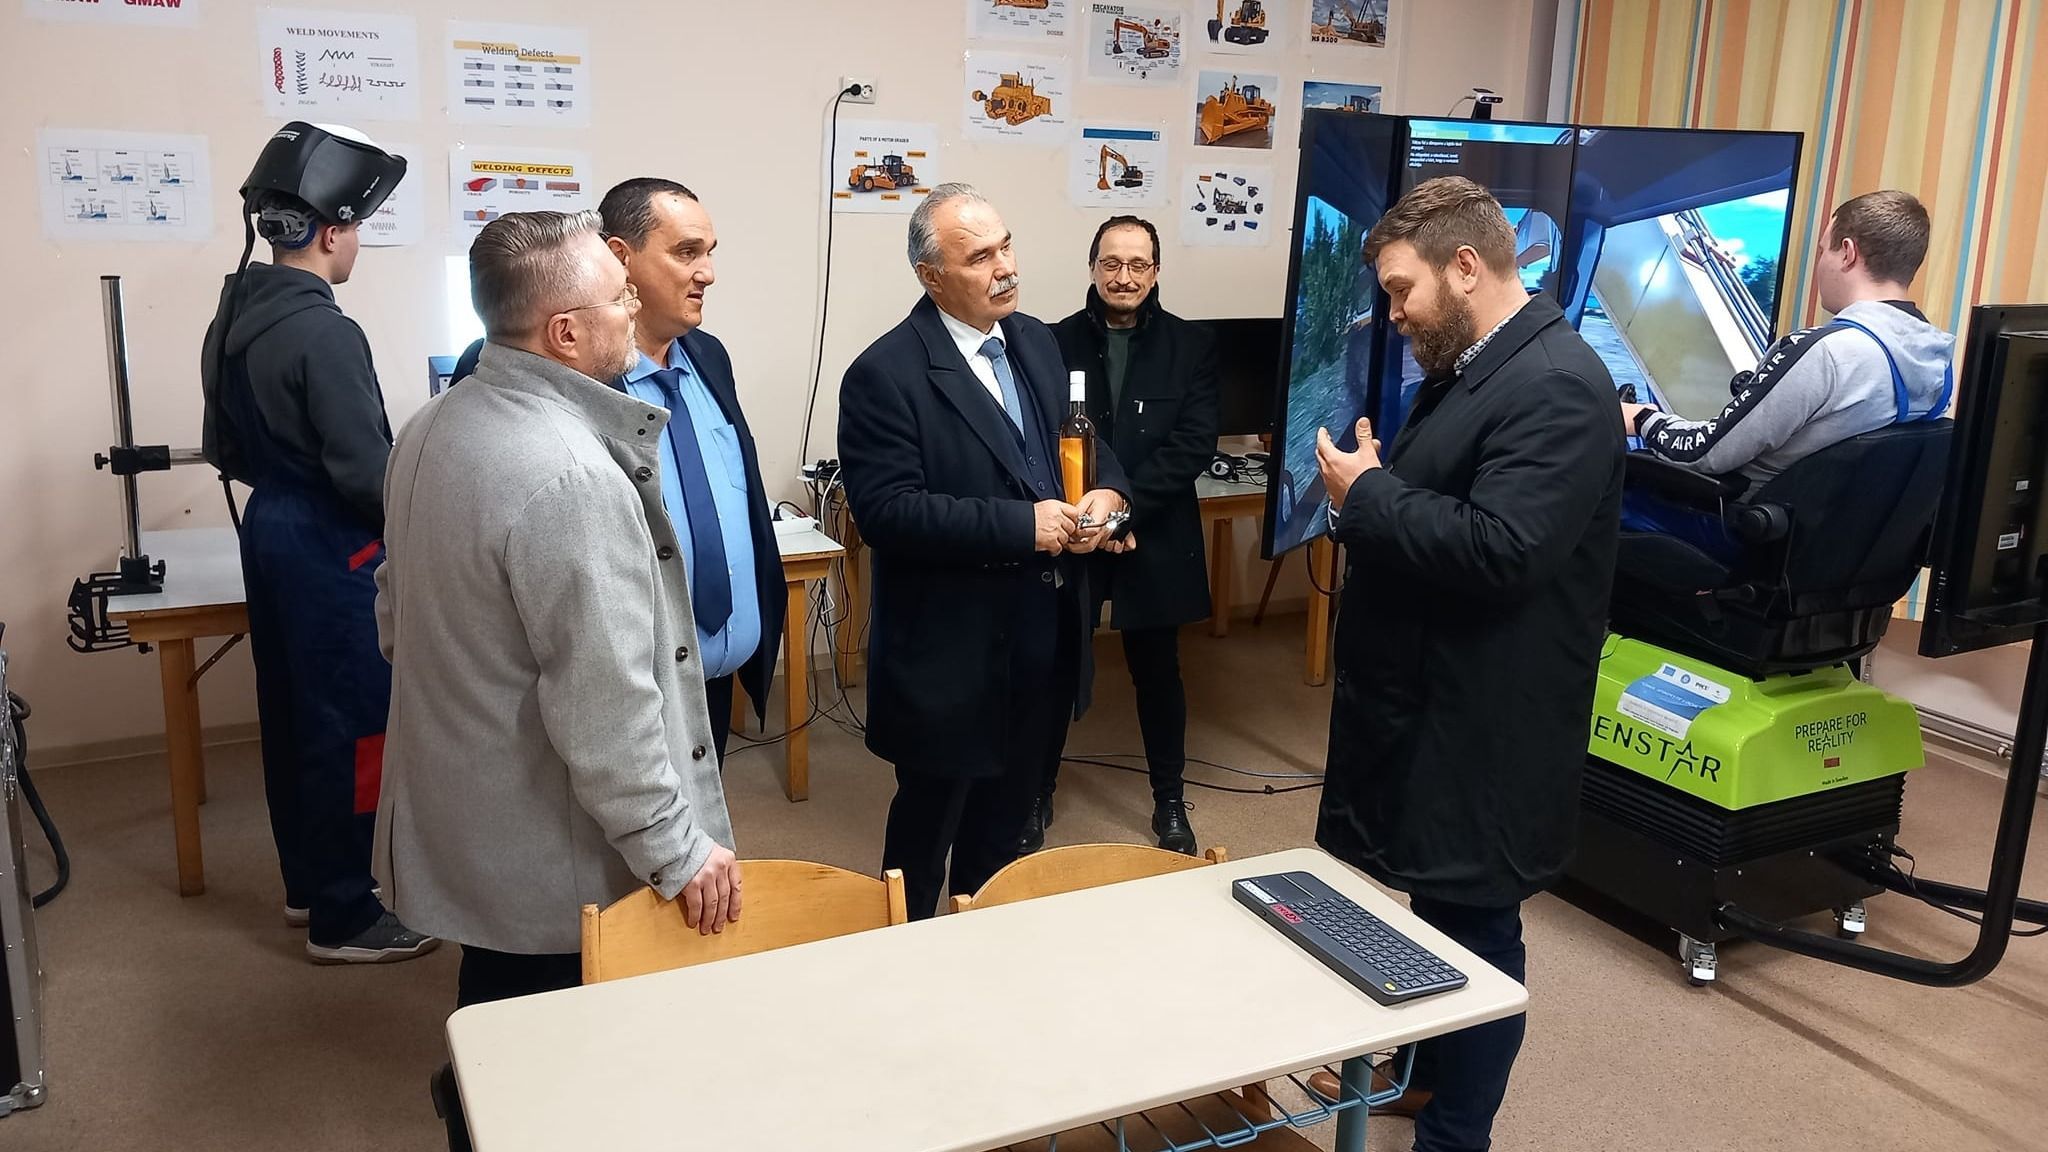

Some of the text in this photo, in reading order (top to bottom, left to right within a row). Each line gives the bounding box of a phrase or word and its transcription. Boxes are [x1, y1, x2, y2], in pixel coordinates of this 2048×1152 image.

[1093, 4, 1124, 12] EXCAVATOR
[287, 27, 380, 40] WELD MOVEMENTS
[482, 46, 554, 58] Welding Defects
[474, 163, 571, 175] WELDING DEFECTS
[1671, 436, 1693, 451] AIR
[1723, 389, 1752, 419] AIR
[1758, 352, 1786, 384] AIR
[1795, 712, 1867, 739] PREPARE FOR
[1593, 715, 1721, 783] ENSTAR
[1808, 730, 1854, 757] REALITY
